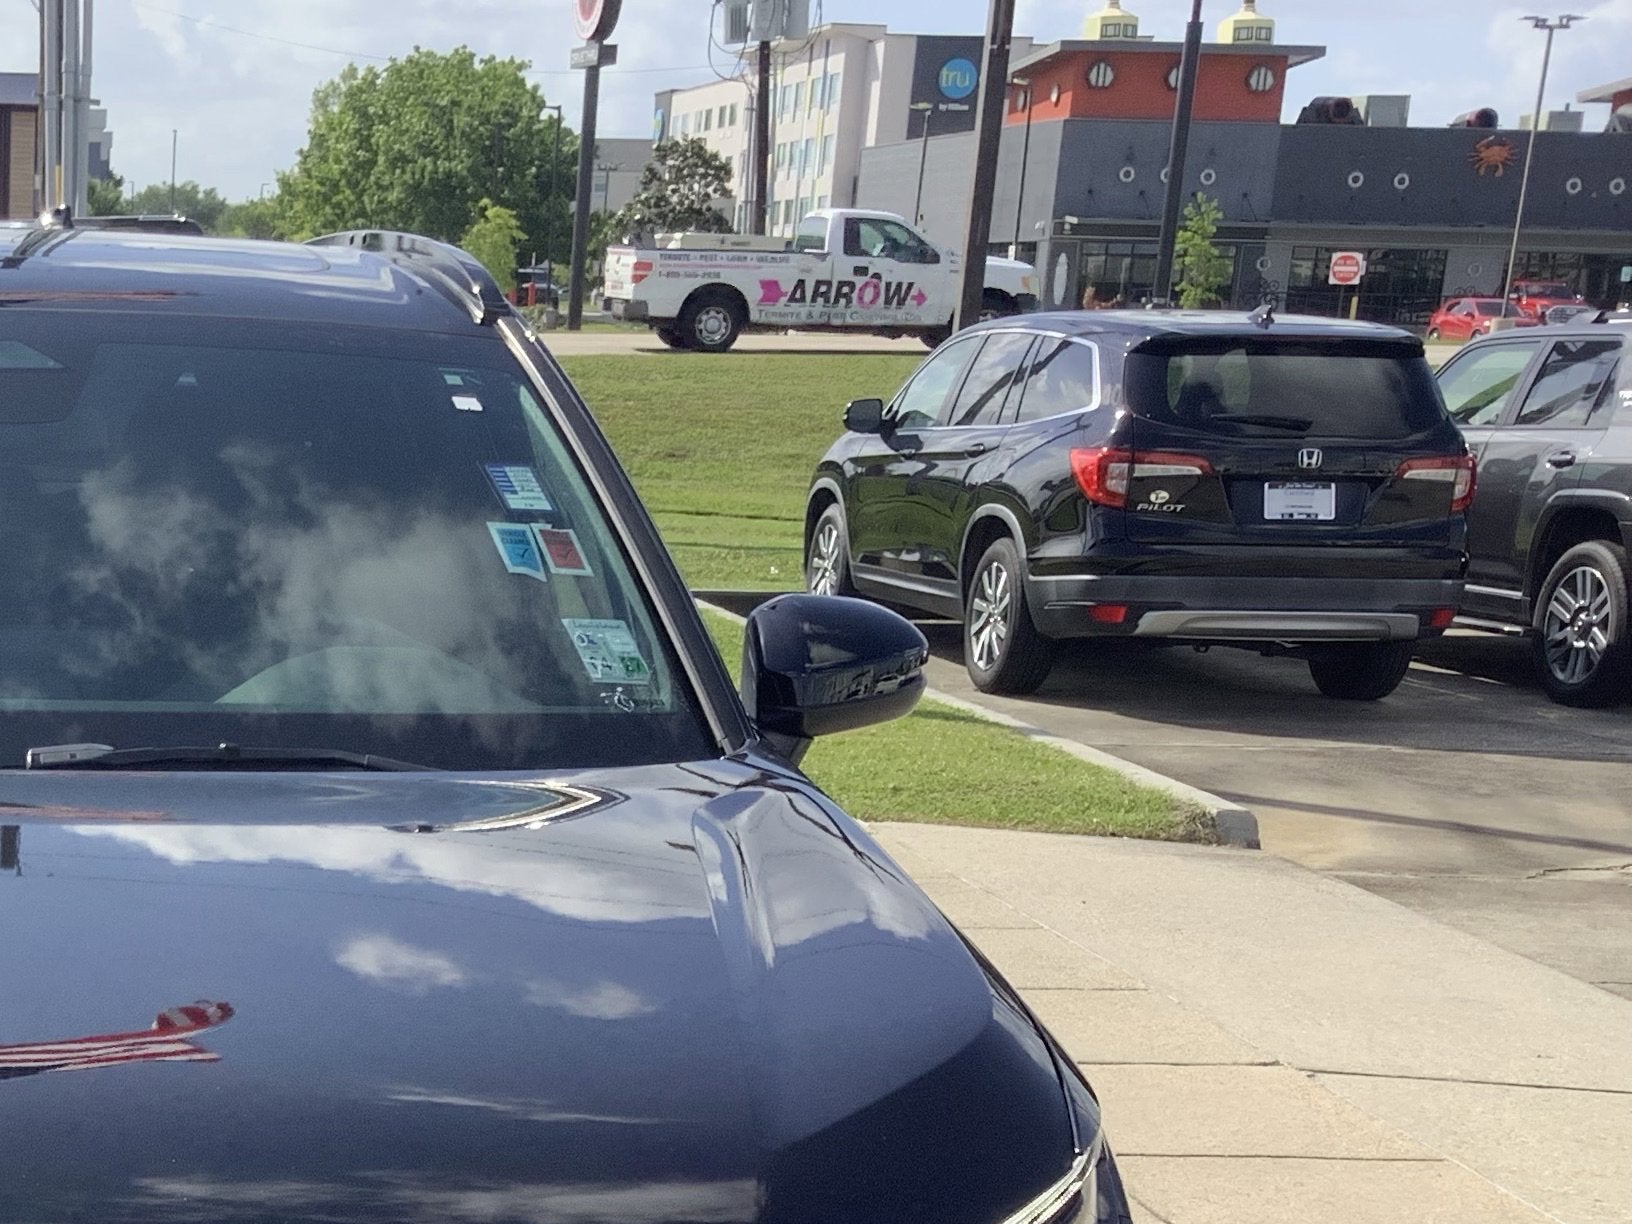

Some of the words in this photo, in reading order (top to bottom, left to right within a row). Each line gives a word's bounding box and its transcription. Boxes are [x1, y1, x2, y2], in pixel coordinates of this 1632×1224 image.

[941, 66, 970, 88] tru
[786, 278, 915, 309] ARROW
[1137, 503, 1186, 513] PILOT
